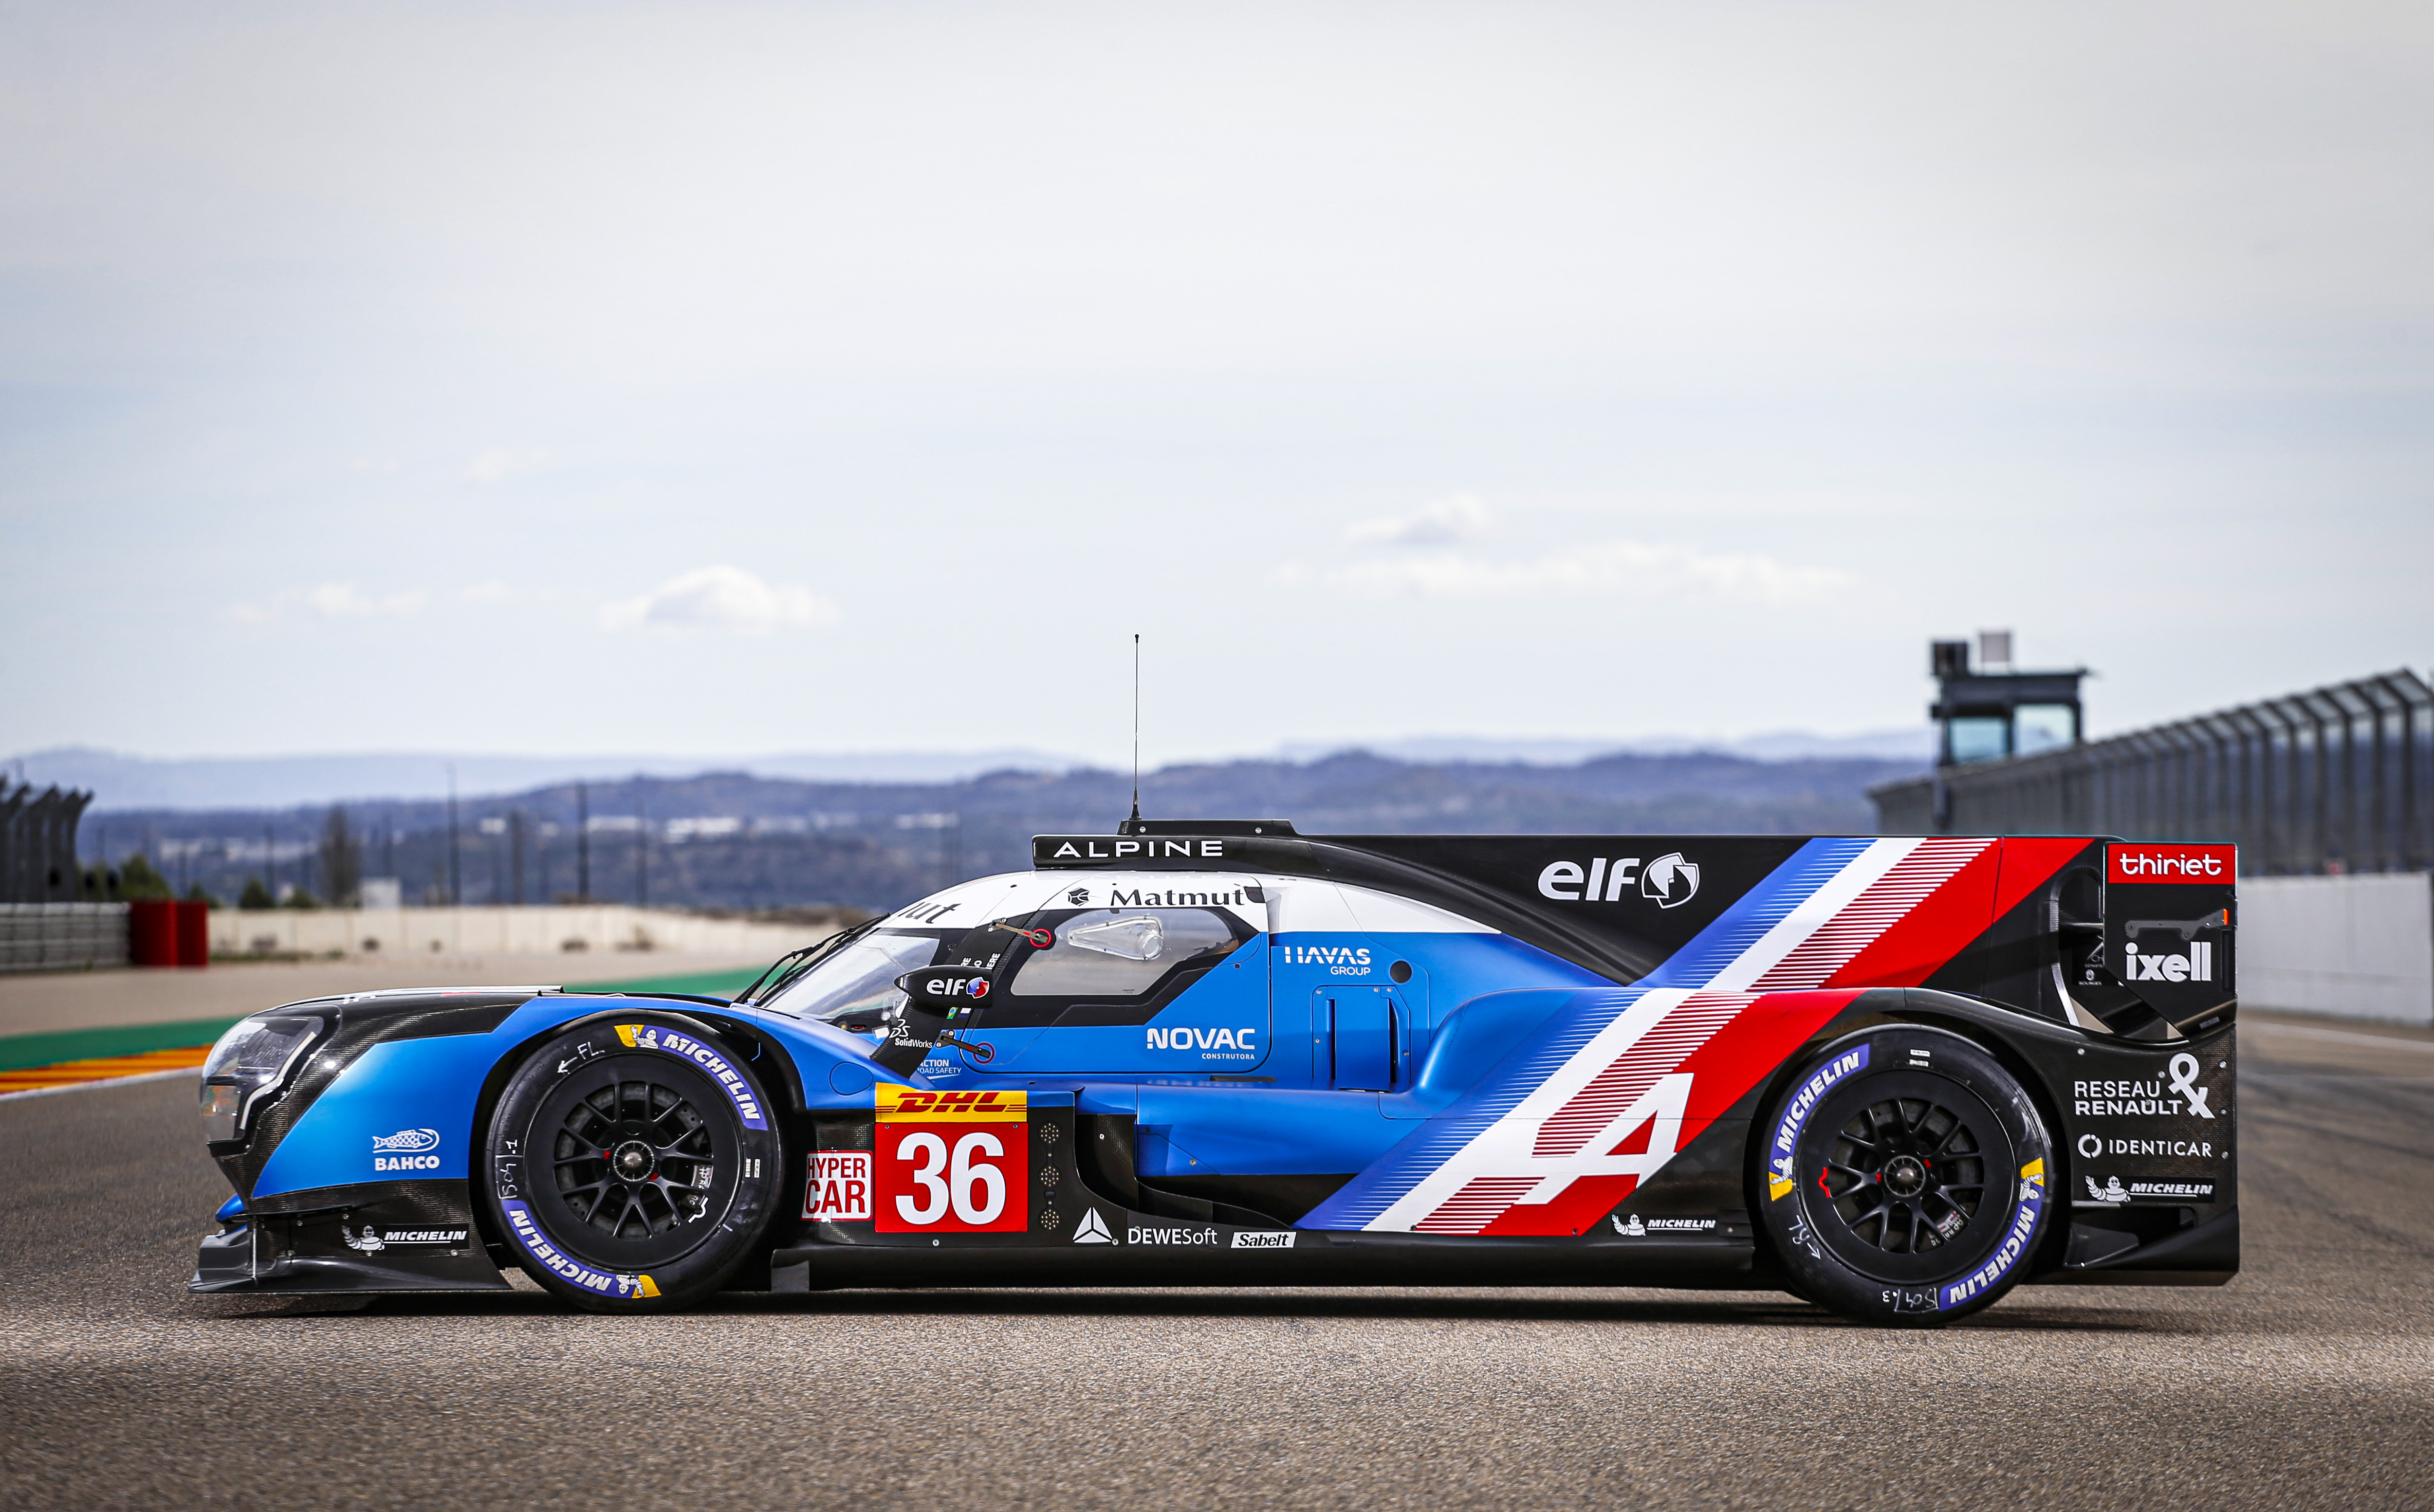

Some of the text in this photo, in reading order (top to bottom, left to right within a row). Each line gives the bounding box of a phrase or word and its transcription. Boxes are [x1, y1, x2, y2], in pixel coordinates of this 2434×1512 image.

[1053, 840, 1223, 857] ALPINE
[2120, 853, 2221, 875] thiriet
[1538, 858, 1641, 902] elf
[1110, 889, 1246, 907] Matmut
[1284, 947, 1371, 965] HAVAS
[2125, 942, 2212, 983] ixell
[1330, 966, 1371, 976] GROUP
[927, 979, 966, 995] elf
[895, 1038, 933, 1048] SolidWorks
[1147, 1028, 1255, 1050] NOVAC
[663, 1034, 760, 1120] MICHELIN
[2074, 1080, 2160, 1097] RESEAU
[896, 1092, 1008, 1113] DHL
[1777, 1052, 1860, 1153] MICHELIN
[2074, 1100, 2182, 1115] RENAULT
[2109, 1139, 2213, 1158] IDENTICAR
[375, 1156, 440, 1171] BAHCO
[808, 1157, 866, 1179] HYPER
[896, 1132, 1006, 1225] 36
[806, 1180, 866, 1214] CAR
[2130, 1183, 2213, 1195] MICHELIN
[1647, 1219, 1715, 1229] MICHELIN
[385, 1231, 467, 1241] MICHELIN
[1128, 1228, 1217, 1245] DEWESoft
[1237, 1233, 1289, 1247] Sabelt
[510, 1209, 612, 1291] MICHELIN
[1950, 1208, 2035, 1303] MICHELIN
